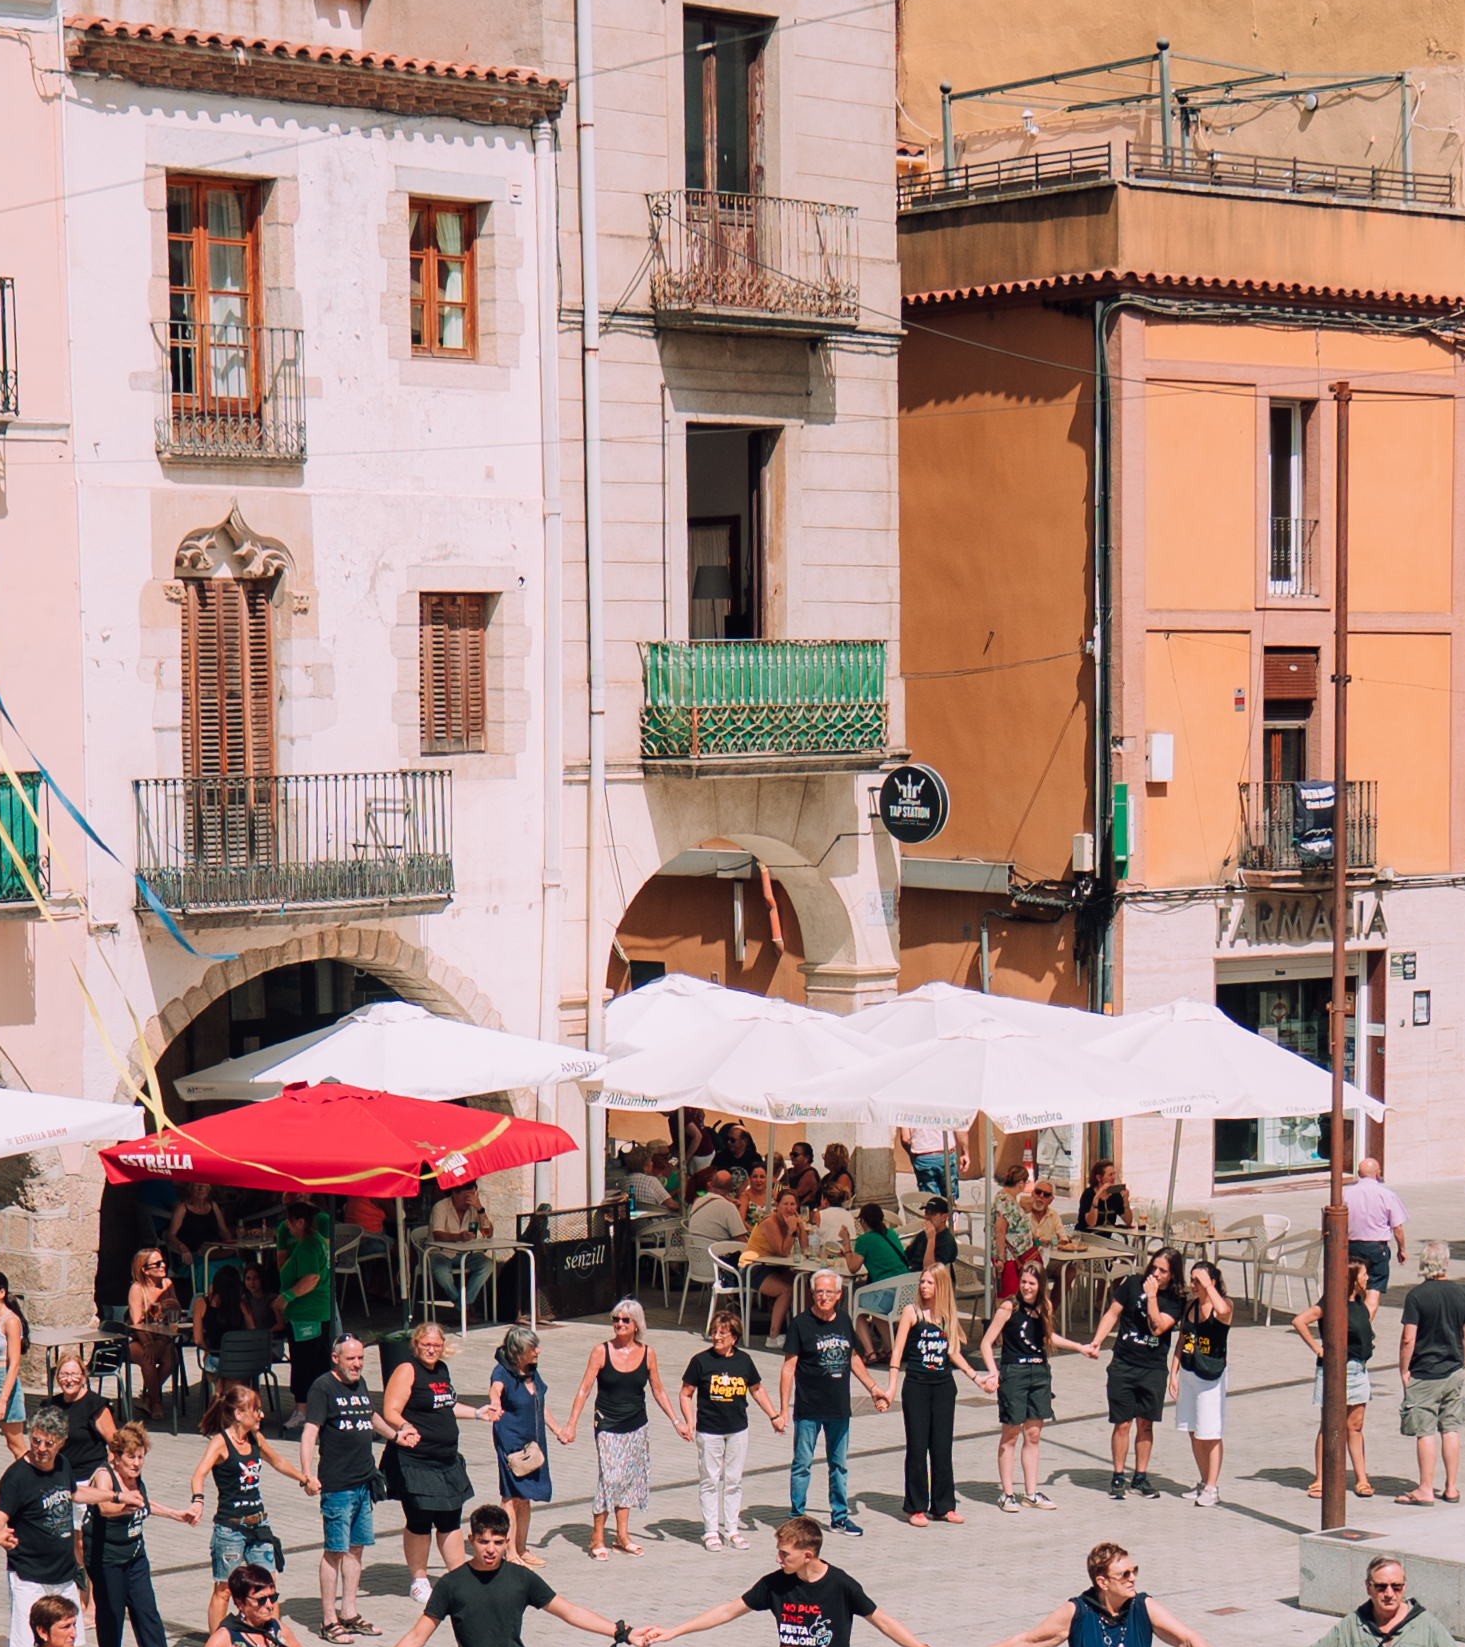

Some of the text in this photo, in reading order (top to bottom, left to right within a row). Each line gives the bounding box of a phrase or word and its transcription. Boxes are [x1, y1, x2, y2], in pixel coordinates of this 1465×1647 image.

[889, 805, 930, 819] TAP STATION
[604, 1091, 659, 1108] Alhambra
[786, 1102, 829, 1120] Alhambra
[1015, 1109, 1063, 1129] Alhambra
[14, 1127, 68, 1145] ESTRELLA DAMM
[118, 1153, 193, 1170] ESTRELLA
[564, 1244, 606, 1270] senzill
[711, 1373, 745, 1388] Força
[709, 1382, 747, 1397] Negra!
[783, 1602, 796, 1613] NO
[779, 1623, 809, 1636] FESTA
[779, 1634, 817, 1646] MAJOR!
